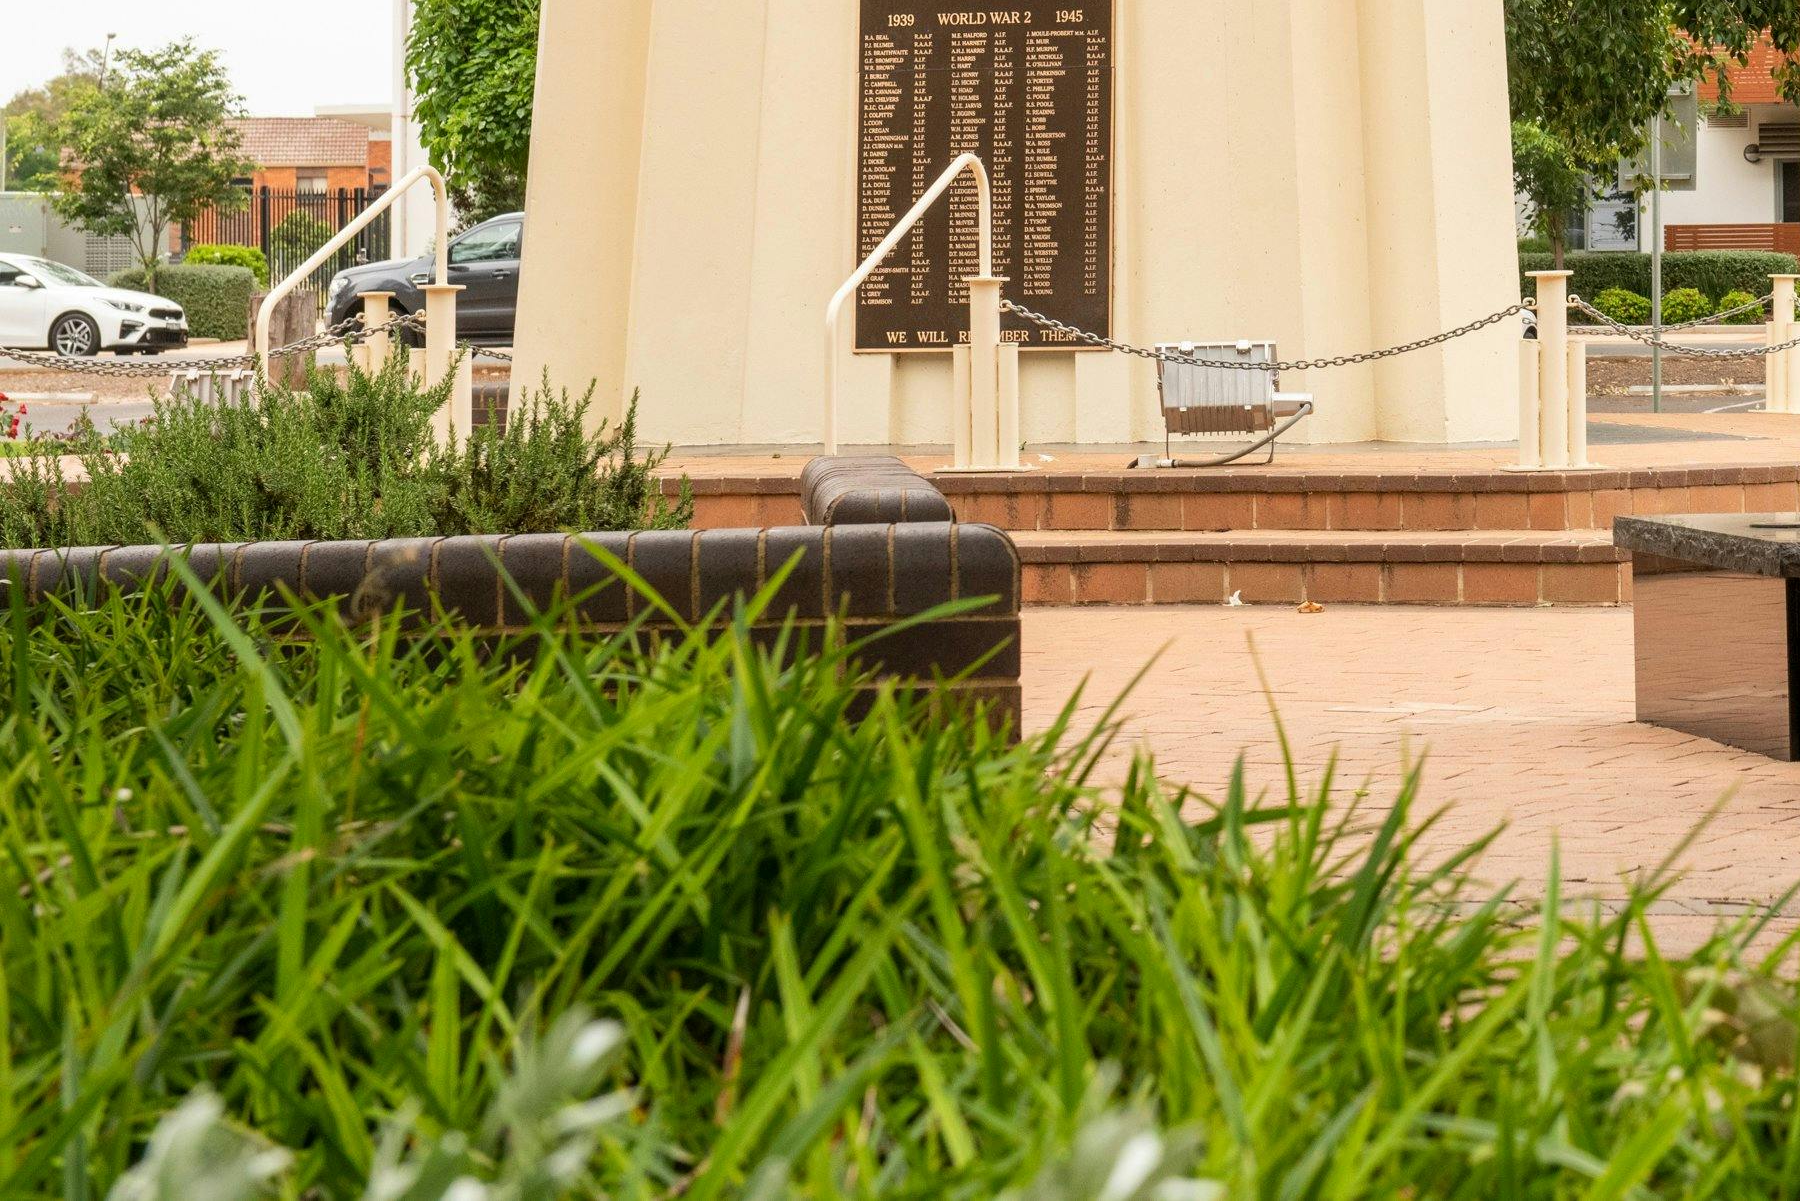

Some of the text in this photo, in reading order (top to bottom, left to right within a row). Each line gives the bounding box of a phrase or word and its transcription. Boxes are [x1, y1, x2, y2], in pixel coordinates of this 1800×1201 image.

[887, 10, 1083, 27] 1939 WORLD WAR 2 1945
[886, 330, 1077, 343] WE WILL RBER THEM
